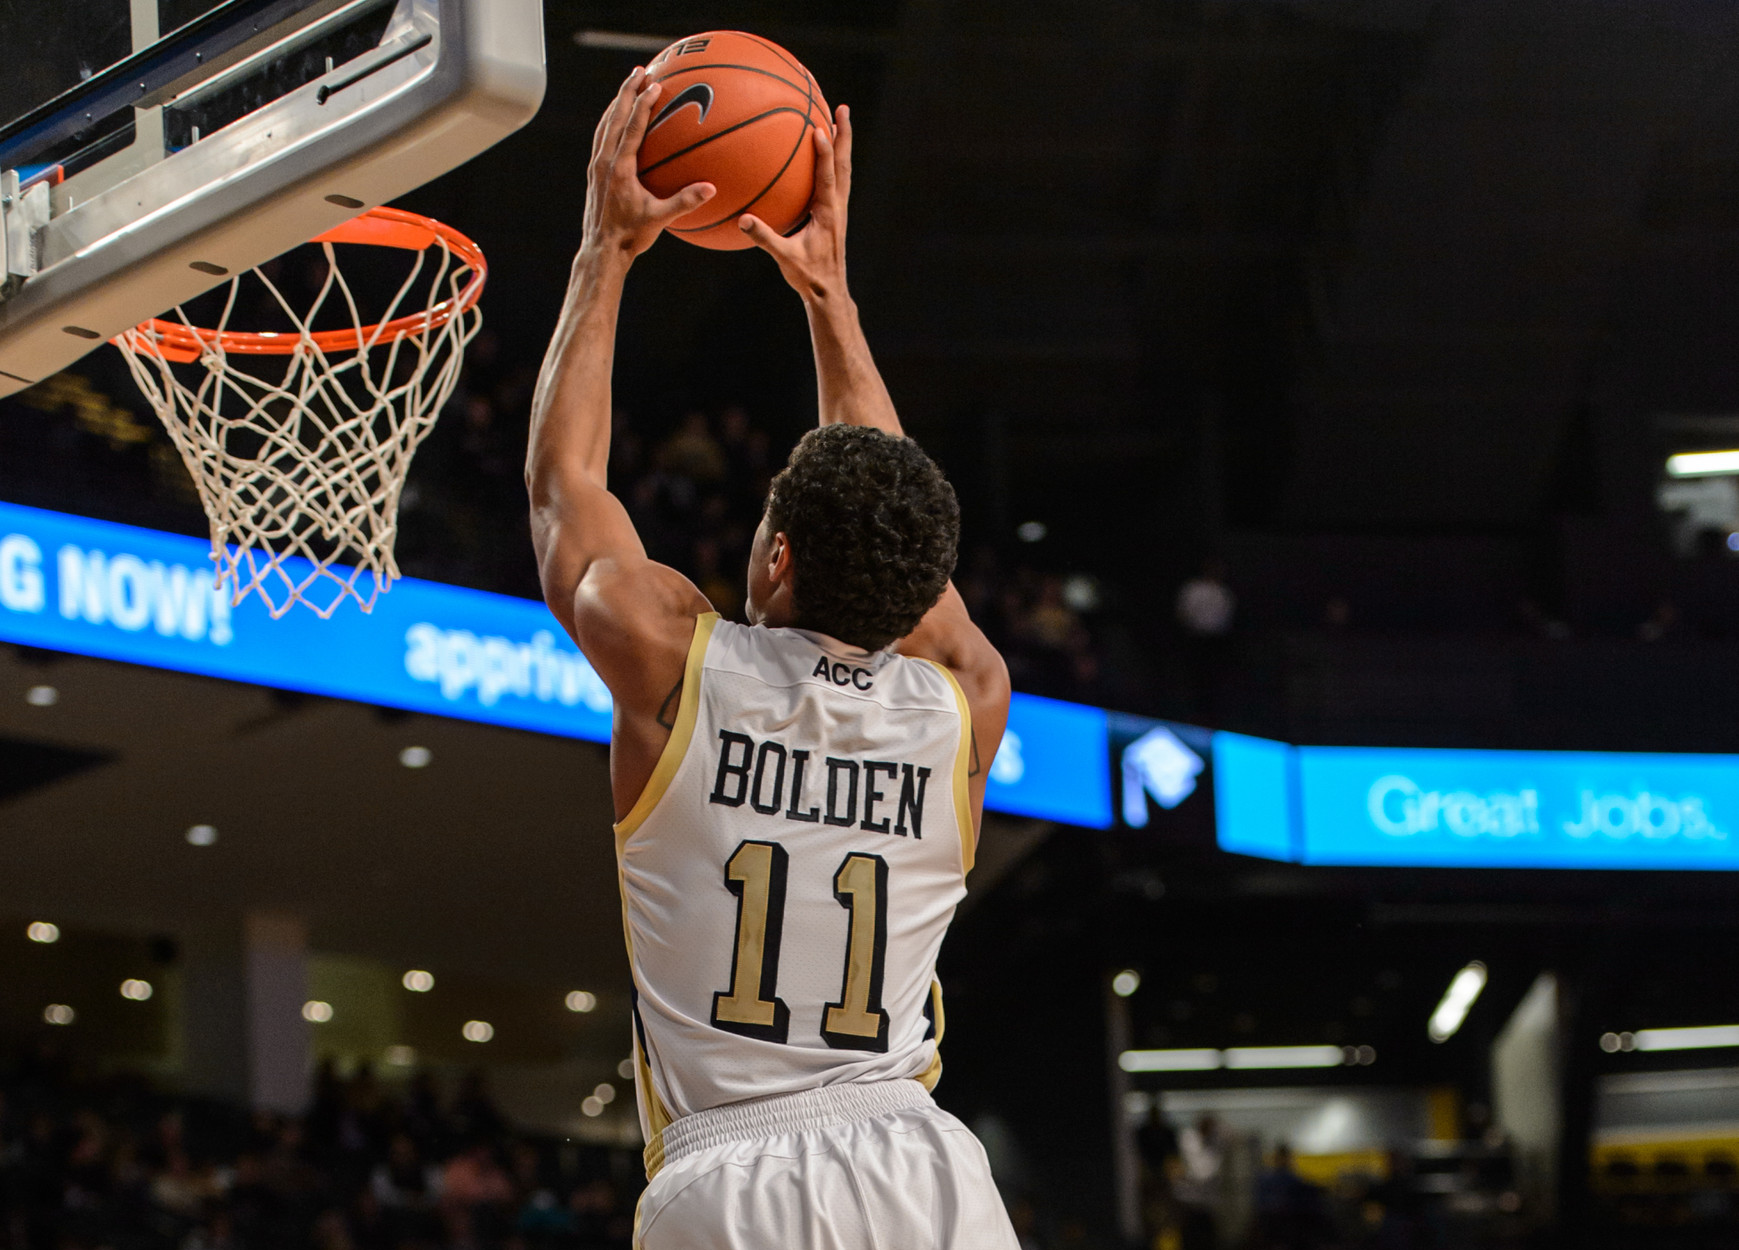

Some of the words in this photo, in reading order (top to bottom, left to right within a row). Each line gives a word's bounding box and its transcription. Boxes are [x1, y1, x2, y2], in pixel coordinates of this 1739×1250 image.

[812, 656, 874, 691] ACC
[709, 729, 932, 840] BOLDEN
[710, 839, 891, 1053] 11
